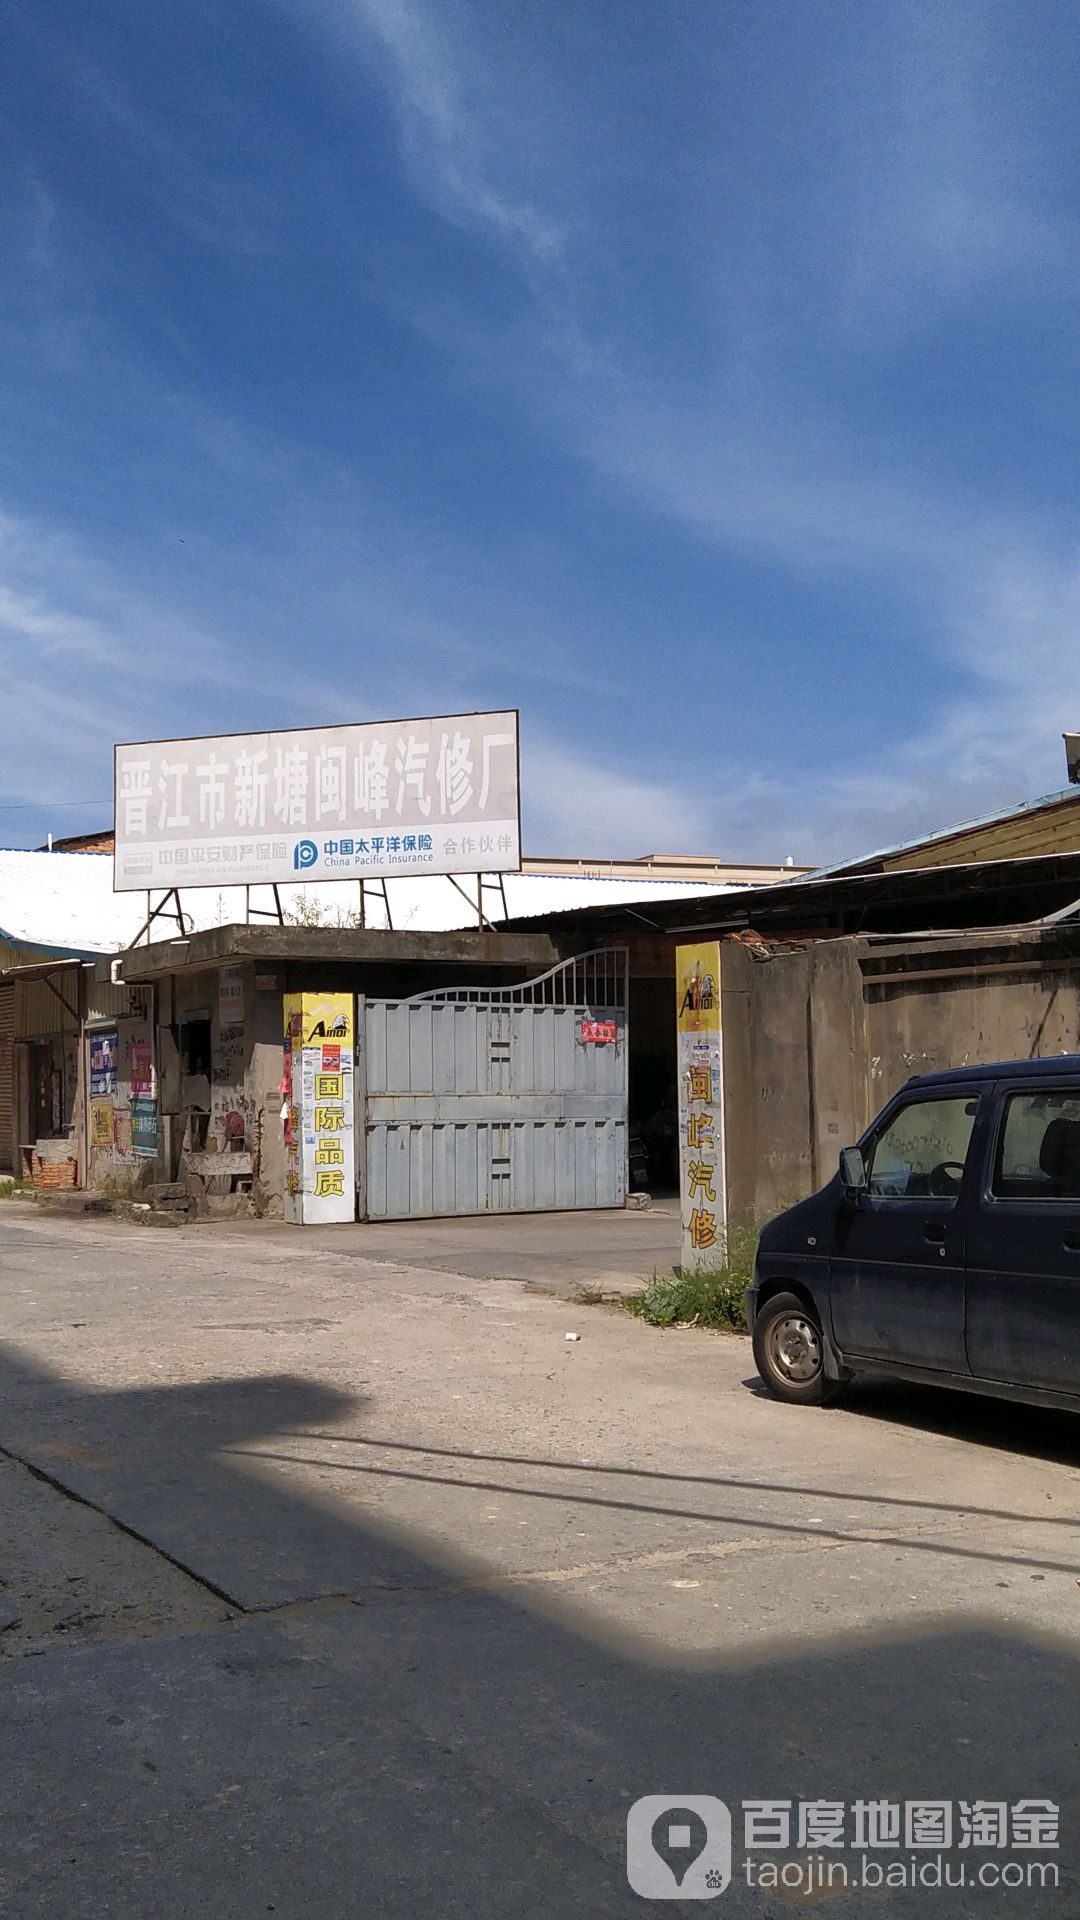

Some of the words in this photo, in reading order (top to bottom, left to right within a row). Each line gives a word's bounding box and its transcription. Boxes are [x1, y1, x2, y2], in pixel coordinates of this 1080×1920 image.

[120, 732, 514, 836] 晋江市新塘闽峰汽修厂
[158, 842, 288, 865] 中国平安财产保险
[324, 834, 434, 856] 中国太平洋保险
[443, 834, 513, 856] 合作伙伴
[324, 857, 350, 868] China
[354, 854, 384, 866] Pacific
[388, 852, 434, 864] Insurance
[313, 1073, 345, 1198] 国际品质
